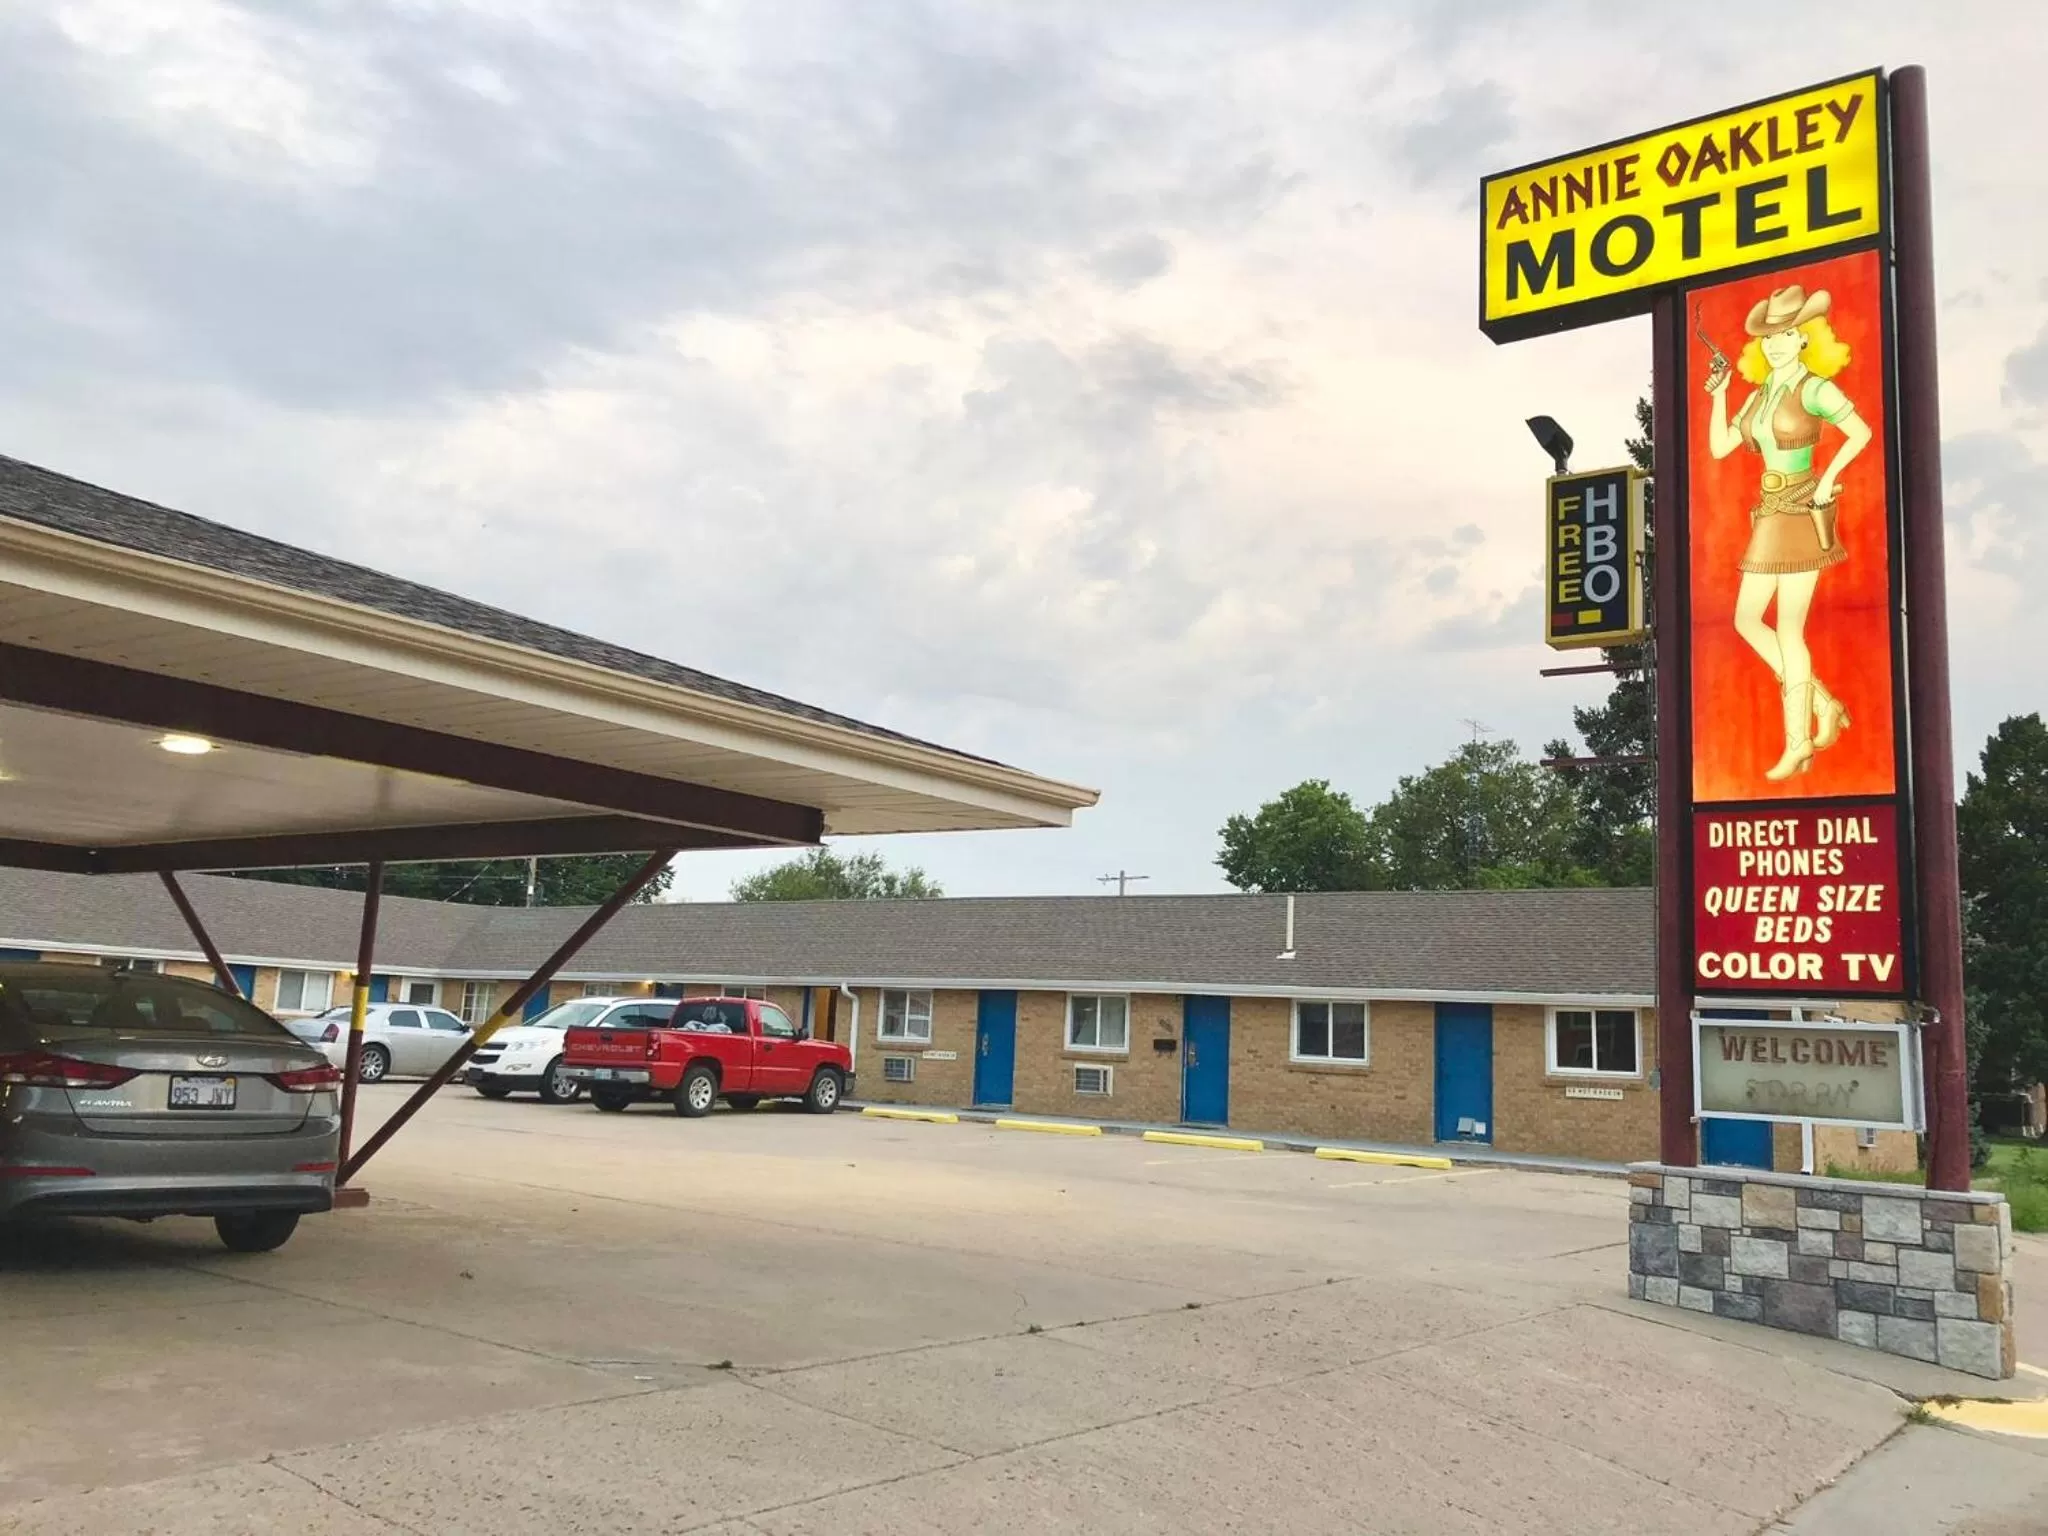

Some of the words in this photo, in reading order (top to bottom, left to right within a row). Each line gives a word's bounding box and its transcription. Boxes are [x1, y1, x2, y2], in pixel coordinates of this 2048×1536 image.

[1496, 153, 1641, 230] ANNIE
[1655, 93, 1863, 188] OAKLEY
[1505, 165, 1862, 301] MOTEL
[1558, 495, 1582, 604] FREE
[1584, 483, 1620, 603] HBO
[1708, 819, 1799, 848] DIRECT
[1817, 816, 1878, 845] DIAL
[1739, 848, 1844, 877] PHONES
[1704, 885, 1800, 917] QUEEN
[1817, 884, 1884, 912] SIZE
[1754, 916, 1833, 943] BEDS
[1698, 952, 1823, 980] COLOR
[1841, 954, 1895, 982] TV
[571, 1043, 643, 1053] CHEVROLET
[1719, 1035, 1889, 1067] WELCOME
